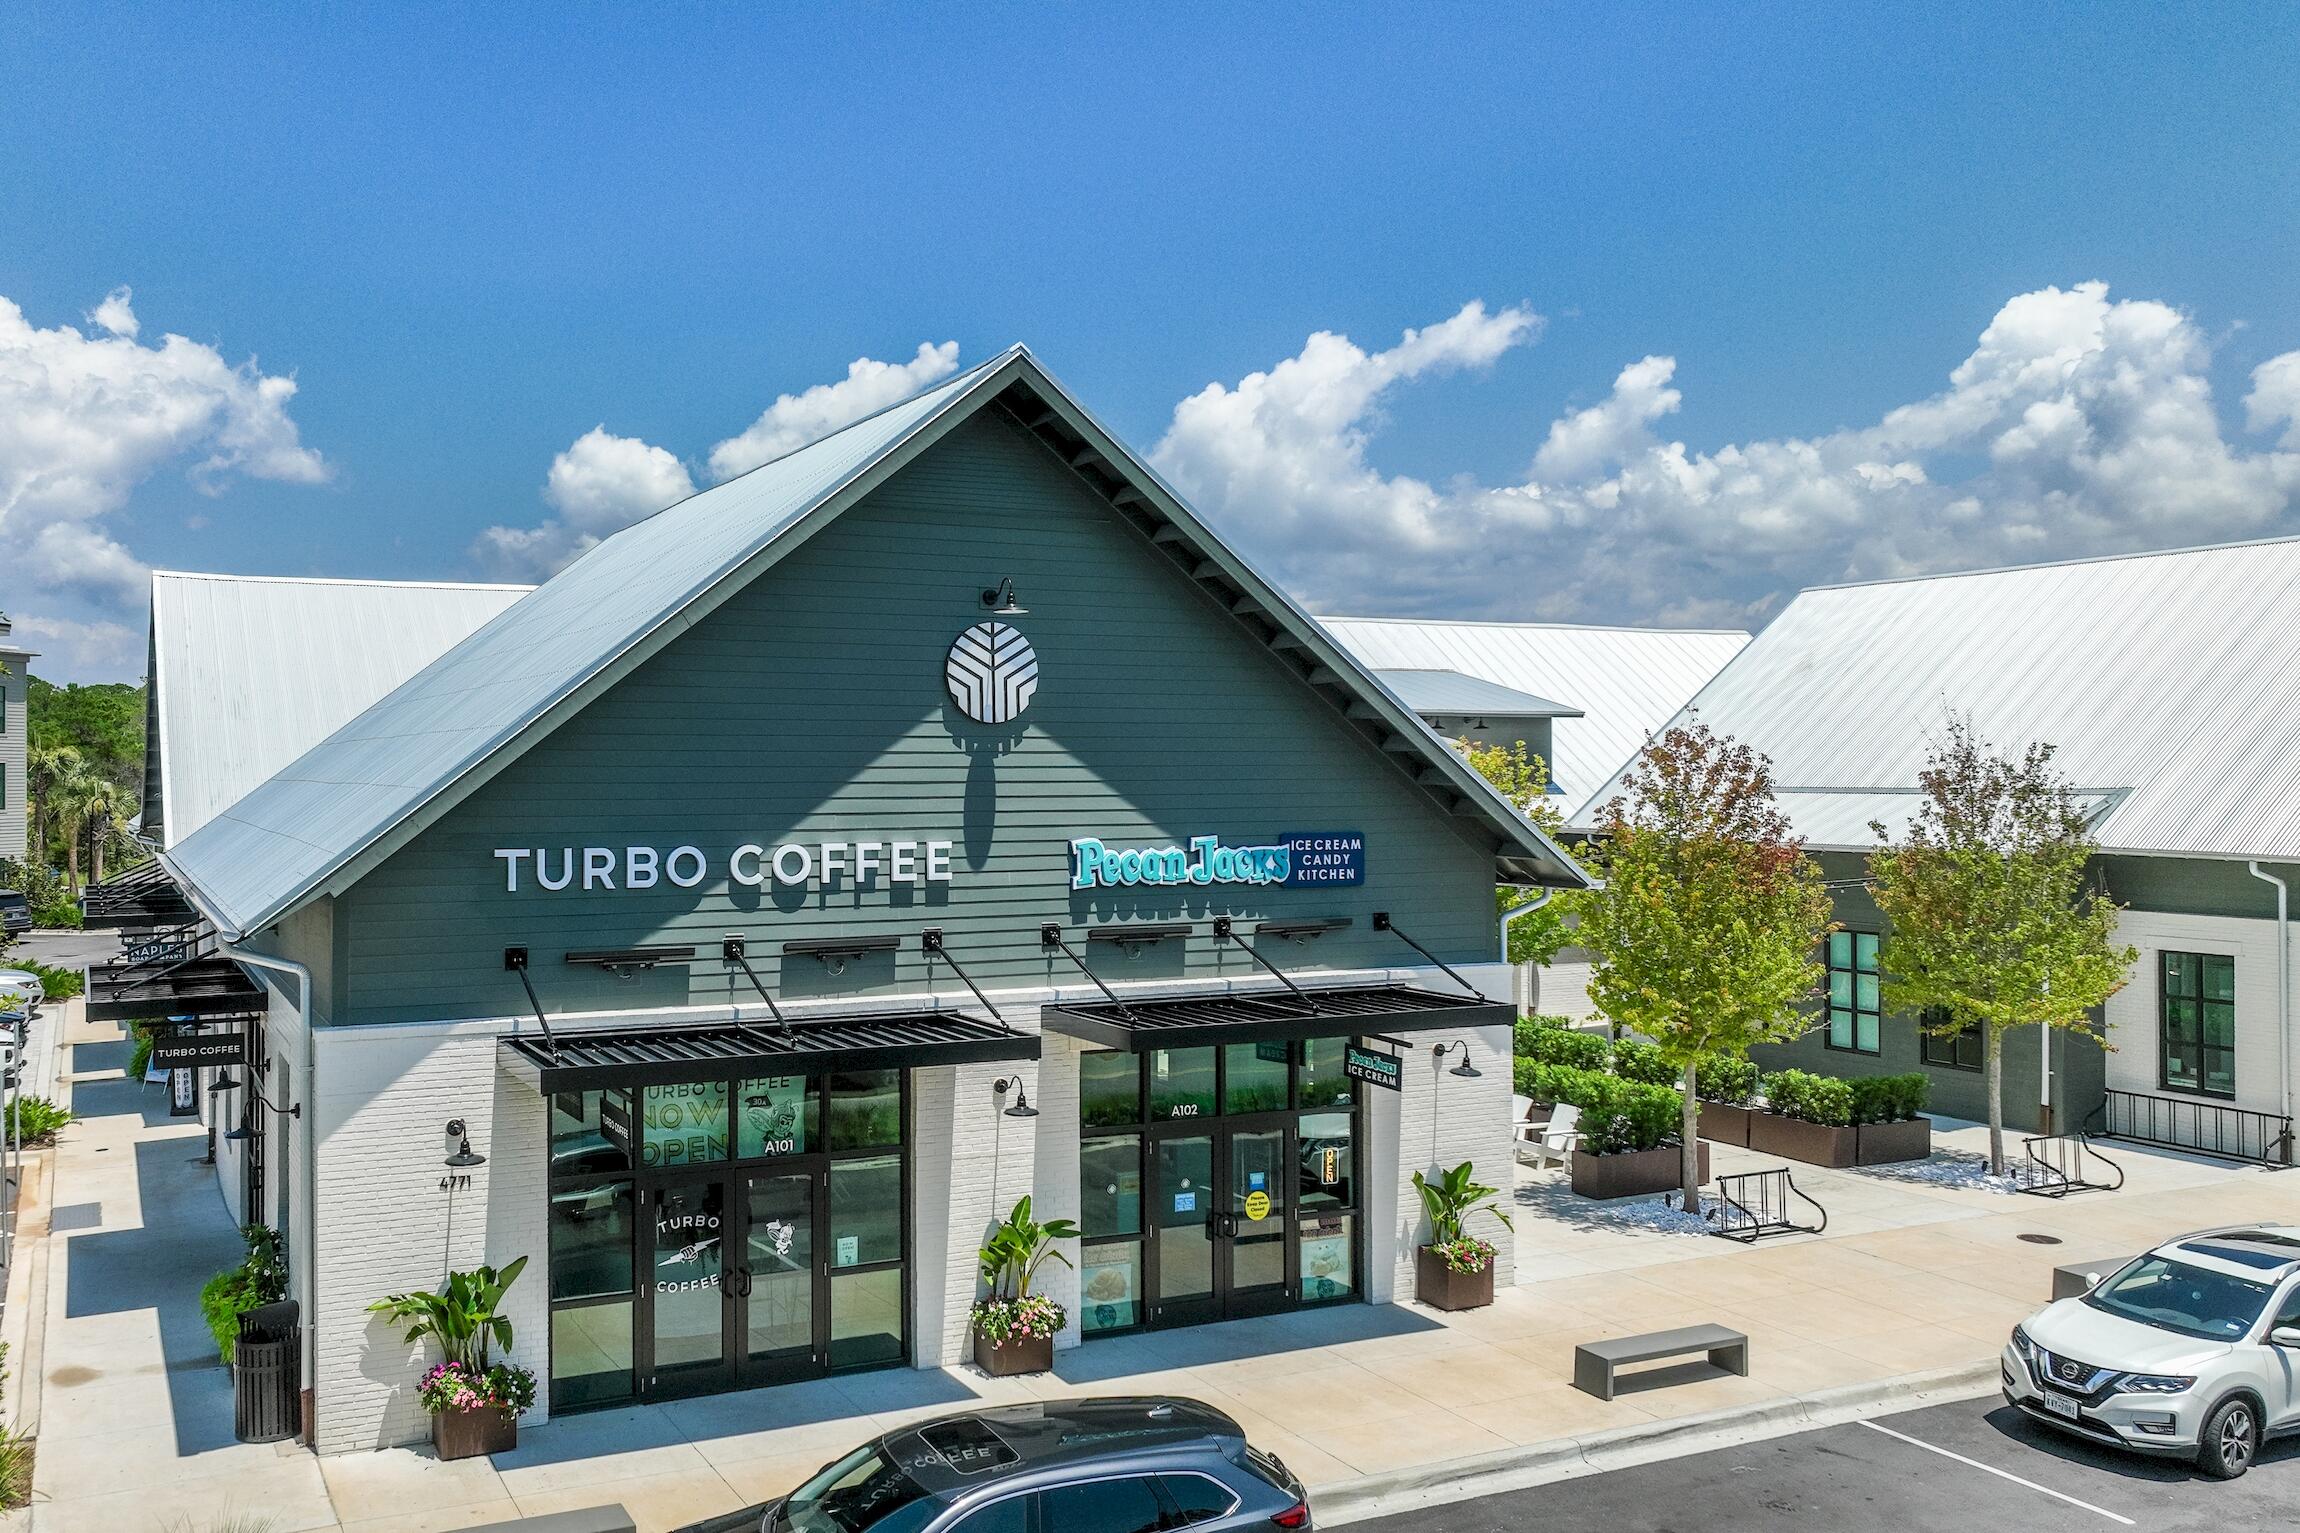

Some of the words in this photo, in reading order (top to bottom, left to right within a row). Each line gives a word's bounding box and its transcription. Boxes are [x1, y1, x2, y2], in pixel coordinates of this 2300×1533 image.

[1291, 840, 1312, 851] ICE
[1314, 839, 1361, 851] CREAM
[494, 845, 707, 892] TURBO
[729, 840, 953, 887] COFFEE
[1071, 838, 1189, 889] Pecan
[1189, 835, 1290, 885] Jacks
[1302, 854, 1350, 865] CANDY
[1298, 869, 1355, 880] KITCHEN
[158, 1048, 197, 1057] TURBO
[200, 1045, 240, 1055] COFFEE
[1348, 1064, 1363, 1077] ICE
[1365, 1070, 1397, 1086] CREAM
[648, 1082, 706, 1099] URBO
[714, 1075, 790, 1094] CFFEE
[753, 1098, 767, 1106] 30A
[1171, 1104, 1198, 1116] A102
[644, 1098, 723, 1131] NOW
[643, 1134, 728, 1166] OPEN
[765, 1140, 793, 1153] A101
[1326, 1149, 1334, 1183] OPEN
[440, 1175, 471, 1190] 4771
[657, 1215, 720, 1233] TURBO
[657, 1273, 720, 1293] COFFEE
